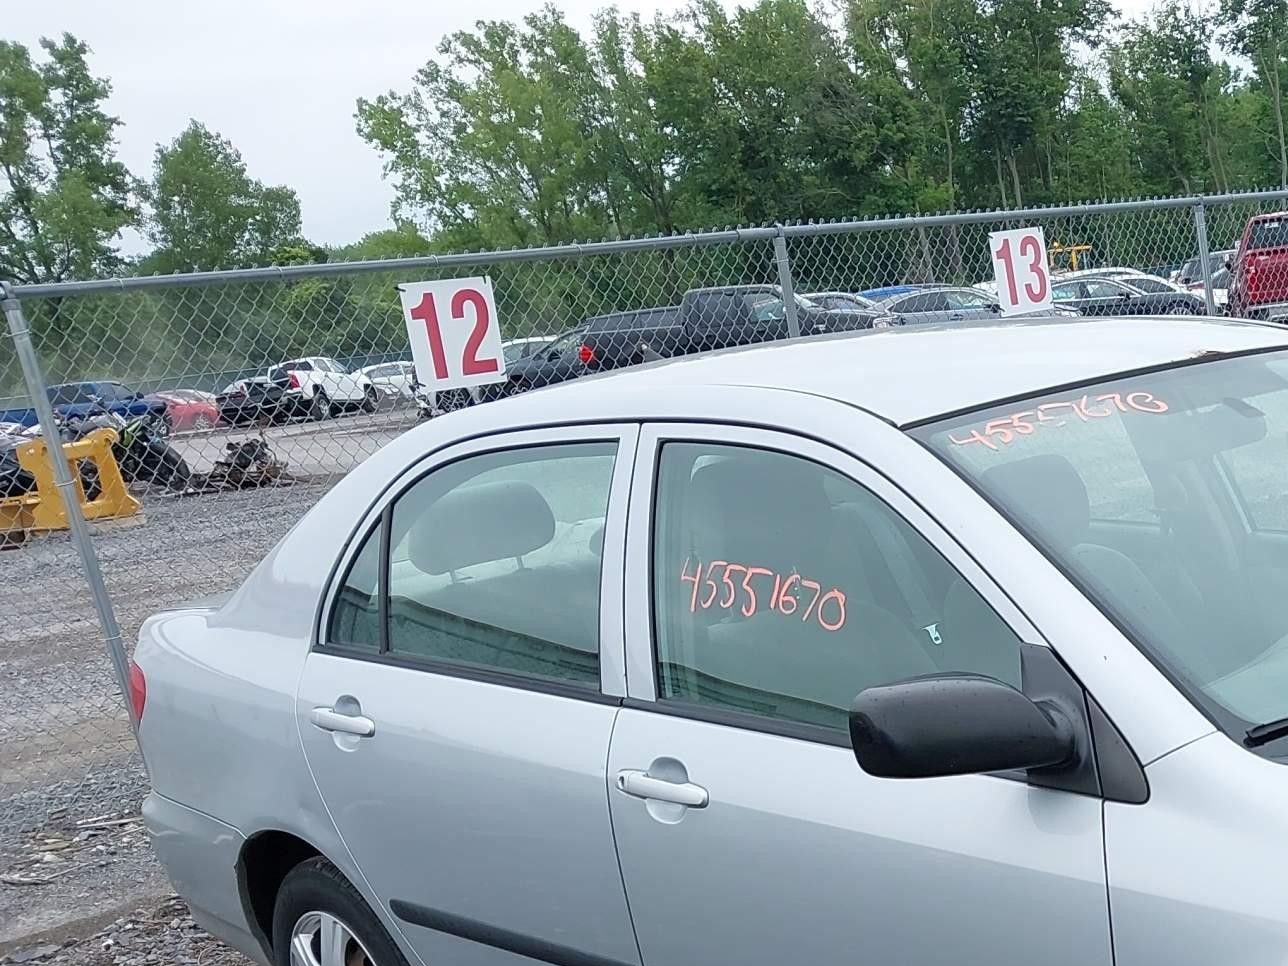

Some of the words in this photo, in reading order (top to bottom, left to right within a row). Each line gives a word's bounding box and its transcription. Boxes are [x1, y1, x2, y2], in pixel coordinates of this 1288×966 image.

[995, 235, 1046, 305] 13
[410, 289, 498, 380] 12
[681, 556, 846, 631] 45551670
